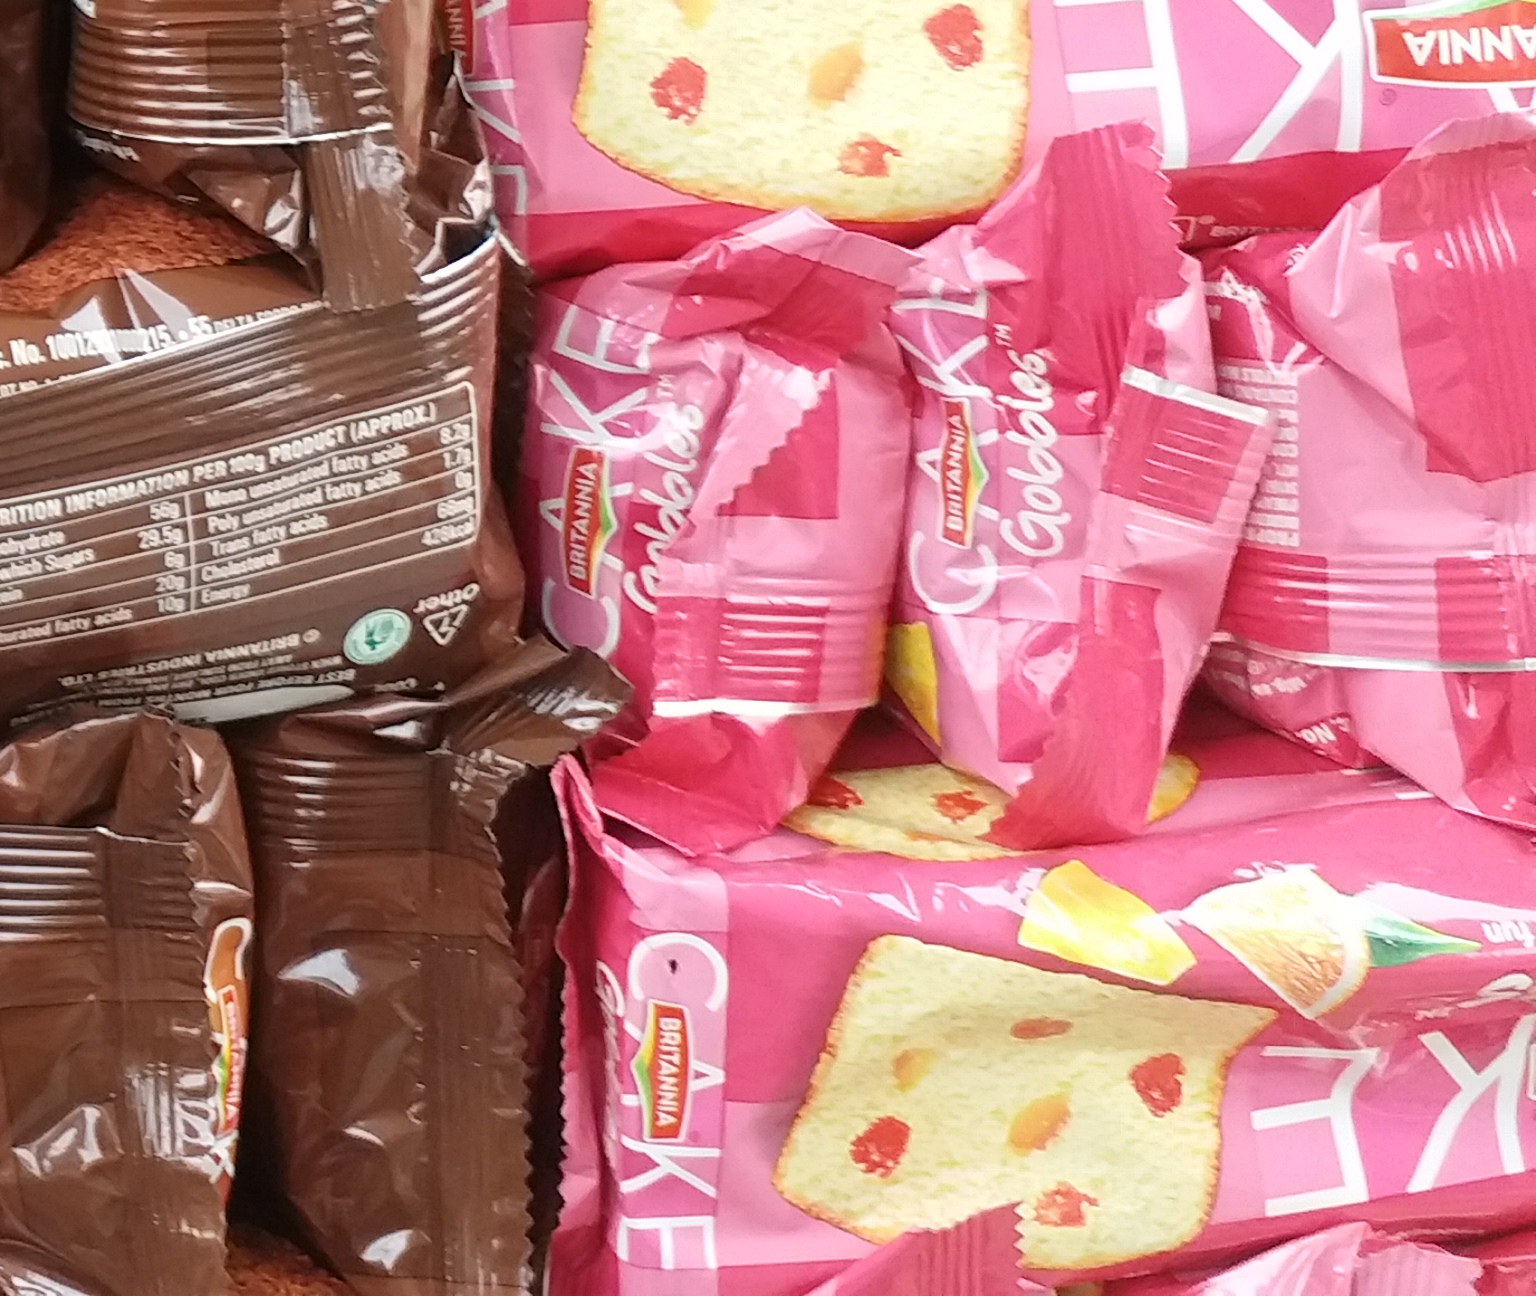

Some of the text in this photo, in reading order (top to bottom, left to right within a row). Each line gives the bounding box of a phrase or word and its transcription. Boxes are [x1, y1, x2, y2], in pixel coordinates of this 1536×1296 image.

[1402, 26, 1536, 67] ANNIA
[10, 341, 46, 368] No.
[64, 468, 190, 514] INFORMATION
[192, 460, 227, 483] PER
[269, 425, 347, 464] PRODUCT
[349, 402, 437, 443] (APPROX.)
[331, 453, 369, 475] fatty
[371, 442, 410, 465] acids
[943, 413, 967, 532] BRITANNIA
[997, 347, 1071, 557] Gobbles
[207, 514, 240, 535] Poly
[325, 480, 362, 501] fatty
[365, 469, 403, 492] acids
[568, 461, 599, 583] BRITANNIA
[209, 512, 329, 557] Trans fatty acids
[44, 547, 96, 571] Sugars
[201, 582, 252, 604] Energy
[413, 583, 480, 613] other
[54, 615, 91, 634] fatty
[94, 607, 134, 627] acids
[56, 631, 301, 688] BRITANNIA INDUSTRIES LTD.
[315, 667, 357, 683] BEST
[1480, 921, 1536, 949] fun
[655, 1017, 683, 1128] BRITANNIA
